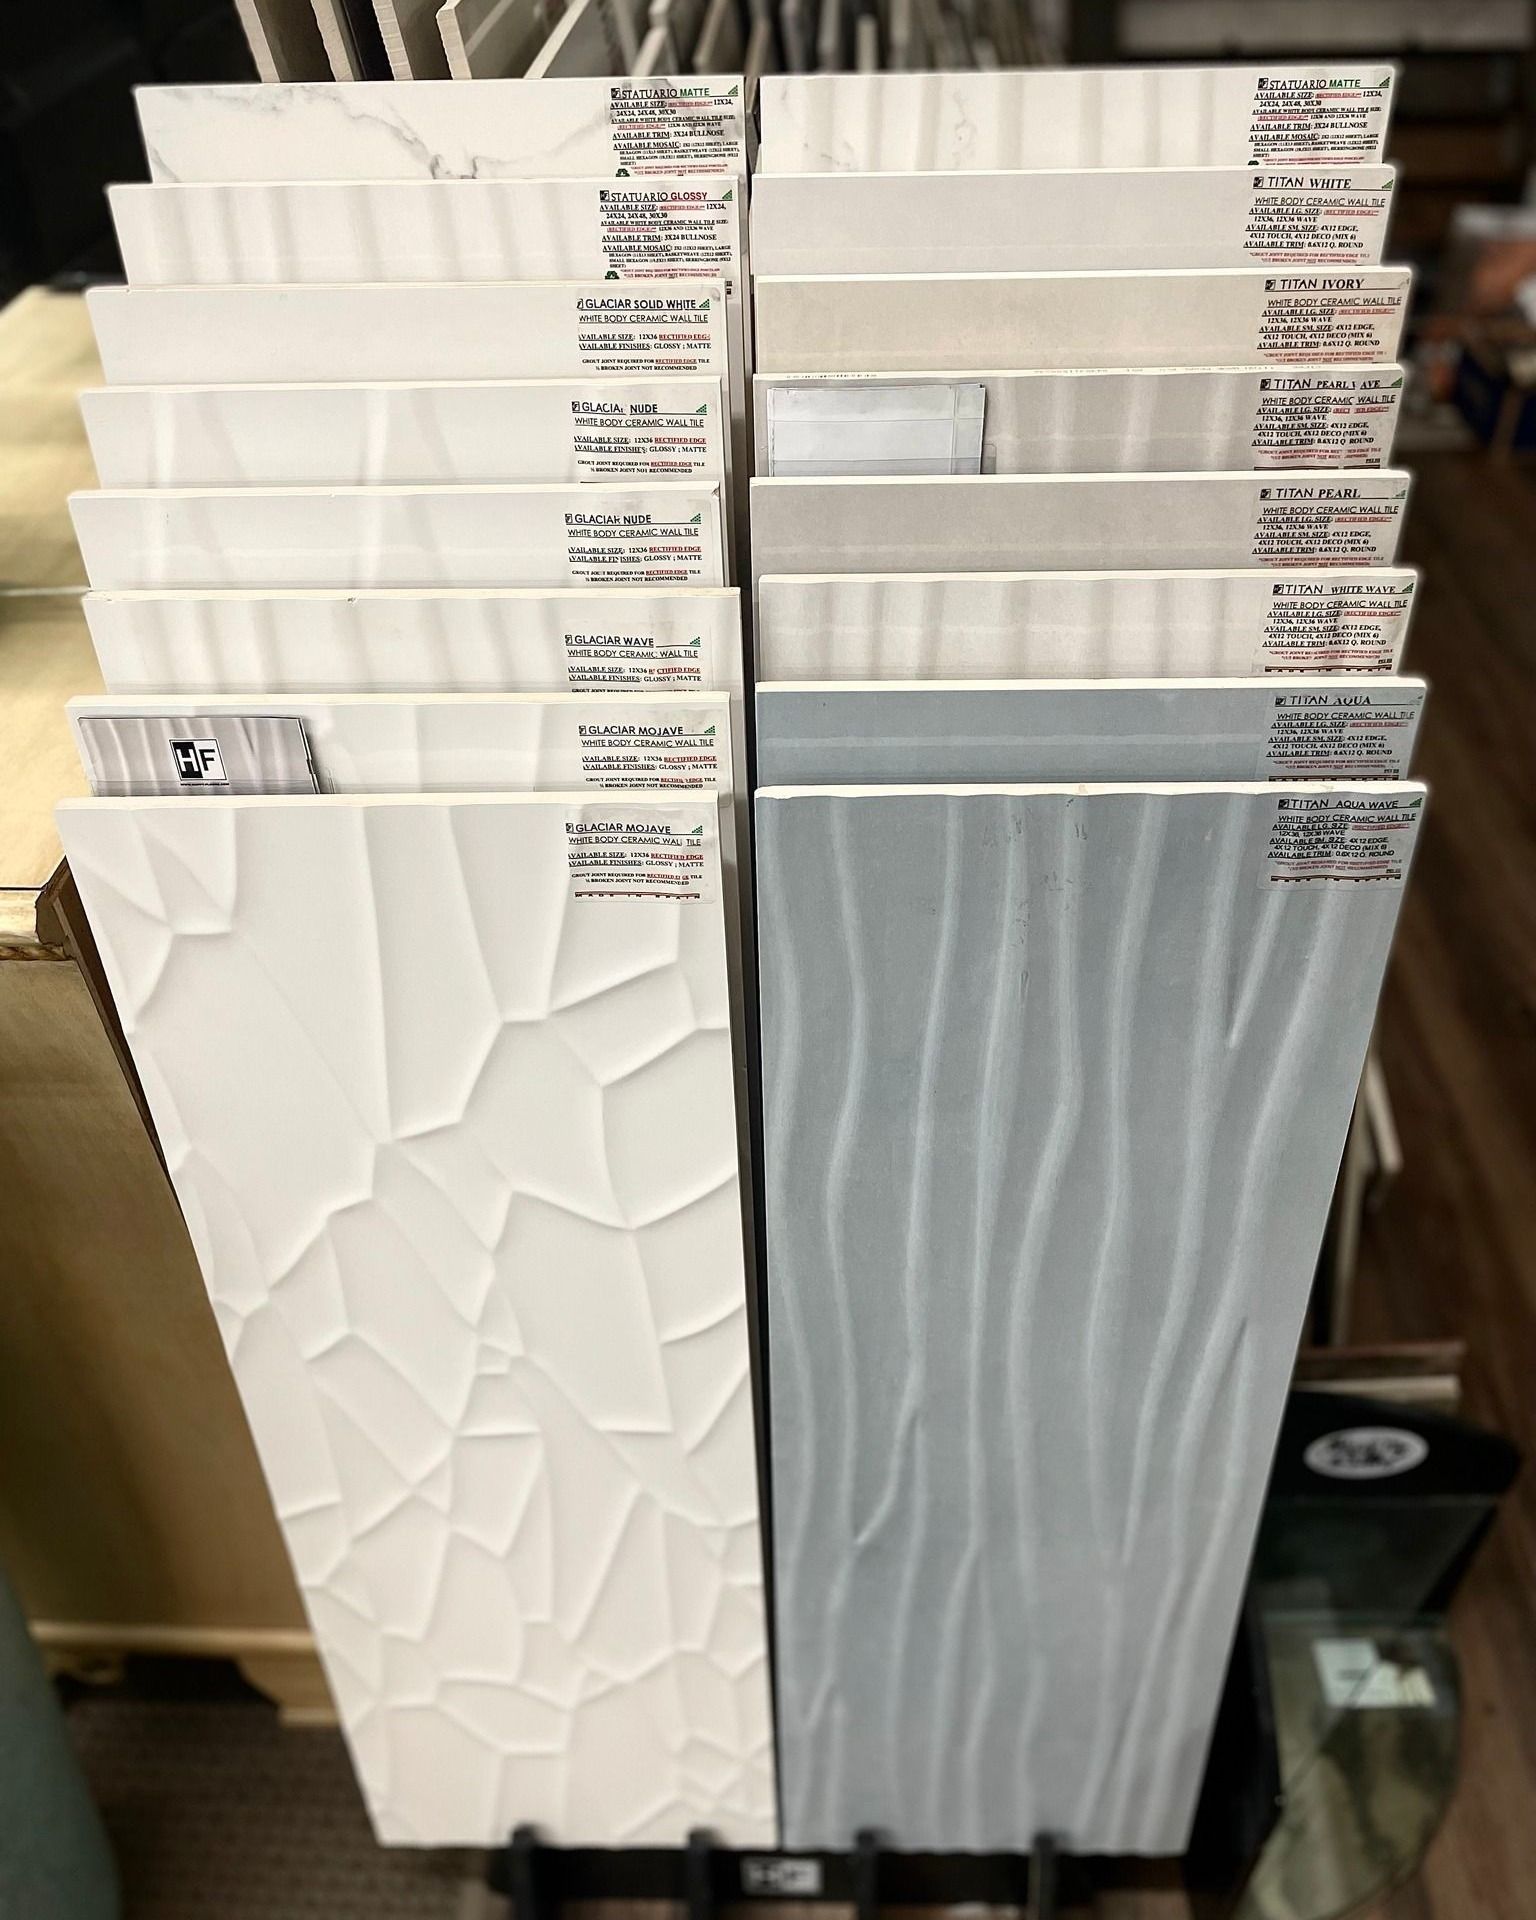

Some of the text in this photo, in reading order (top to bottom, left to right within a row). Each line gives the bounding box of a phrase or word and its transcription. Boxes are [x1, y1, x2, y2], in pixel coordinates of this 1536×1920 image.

[1269, 80, 1326, 90] STATUARIO
[622, 88, 710, 98] STATUARIO MATTE
[1254, 92, 1296, 100] AVAILABLE
[610, 101, 649, 109] AVAILABLE
[1268, 176, 1351, 189] TITAN WHITE
[611, 192, 708, 201] STATUARIO GLOSSY
[1255, 197, 1279, 205] WHITE
[1306, 198, 1345, 206] CERAMIC
[1348, 198, 1369, 206] WALL
[1280, 279, 1365, 289] TITAN IVORY
[586, 299, 696, 309] GLACIAR SOLID WHITE
[1268, 299, 1292, 307] WHITE
[1320, 298, 1360, 306] CERAMIC
[1363, 297, 1384, 305] WALL
[1387, 297, 1402, 305] TILE
[1274, 379, 1311, 389] TITAN
[1317, 381, 1346, 389] PEARL
[1262, 397, 1287, 405] WHITE
[1289, 396, 1312, 405] BODY
[1315, 396, 1354, 404] CERAMIC
[1382, 395, 1396, 403] TILE
[630, 404, 658, 413] NUDE
[575, 417, 598, 425] WHITE
[625, 419, 663, 427] CERAMIC
[690, 419, 704, 427] TILE
[1276, 488, 1360, 498] TITAN PEARL
[1316, 506, 1357, 514] CERAMIC
[623, 515, 651, 524] NUDE
[619, 529, 658, 537] CERAMIC
[1285, 585, 1323, 594] TITAN
[1331, 586, 1363, 594] WHITE
[575, 635, 654, 646] GLACIAR WAVE
[660, 650, 681, 658] WALL
[1290, 696, 1371, 706] TITAN AQUA
[1400, 711, 1415, 719] TILE
[589, 726, 683, 735] GLACIAR MOJAVE
[176, 749, 215, 771] HF
[1291, 799, 1398, 809] TITAN AQUA WAVE
[1333, 814, 1375, 822] CERAMIC
[1402, 813, 1416, 821] TILE
[576, 823, 670, 833] GLACIAR MOJAVE
[621, 836, 660, 844] CERAMIC
